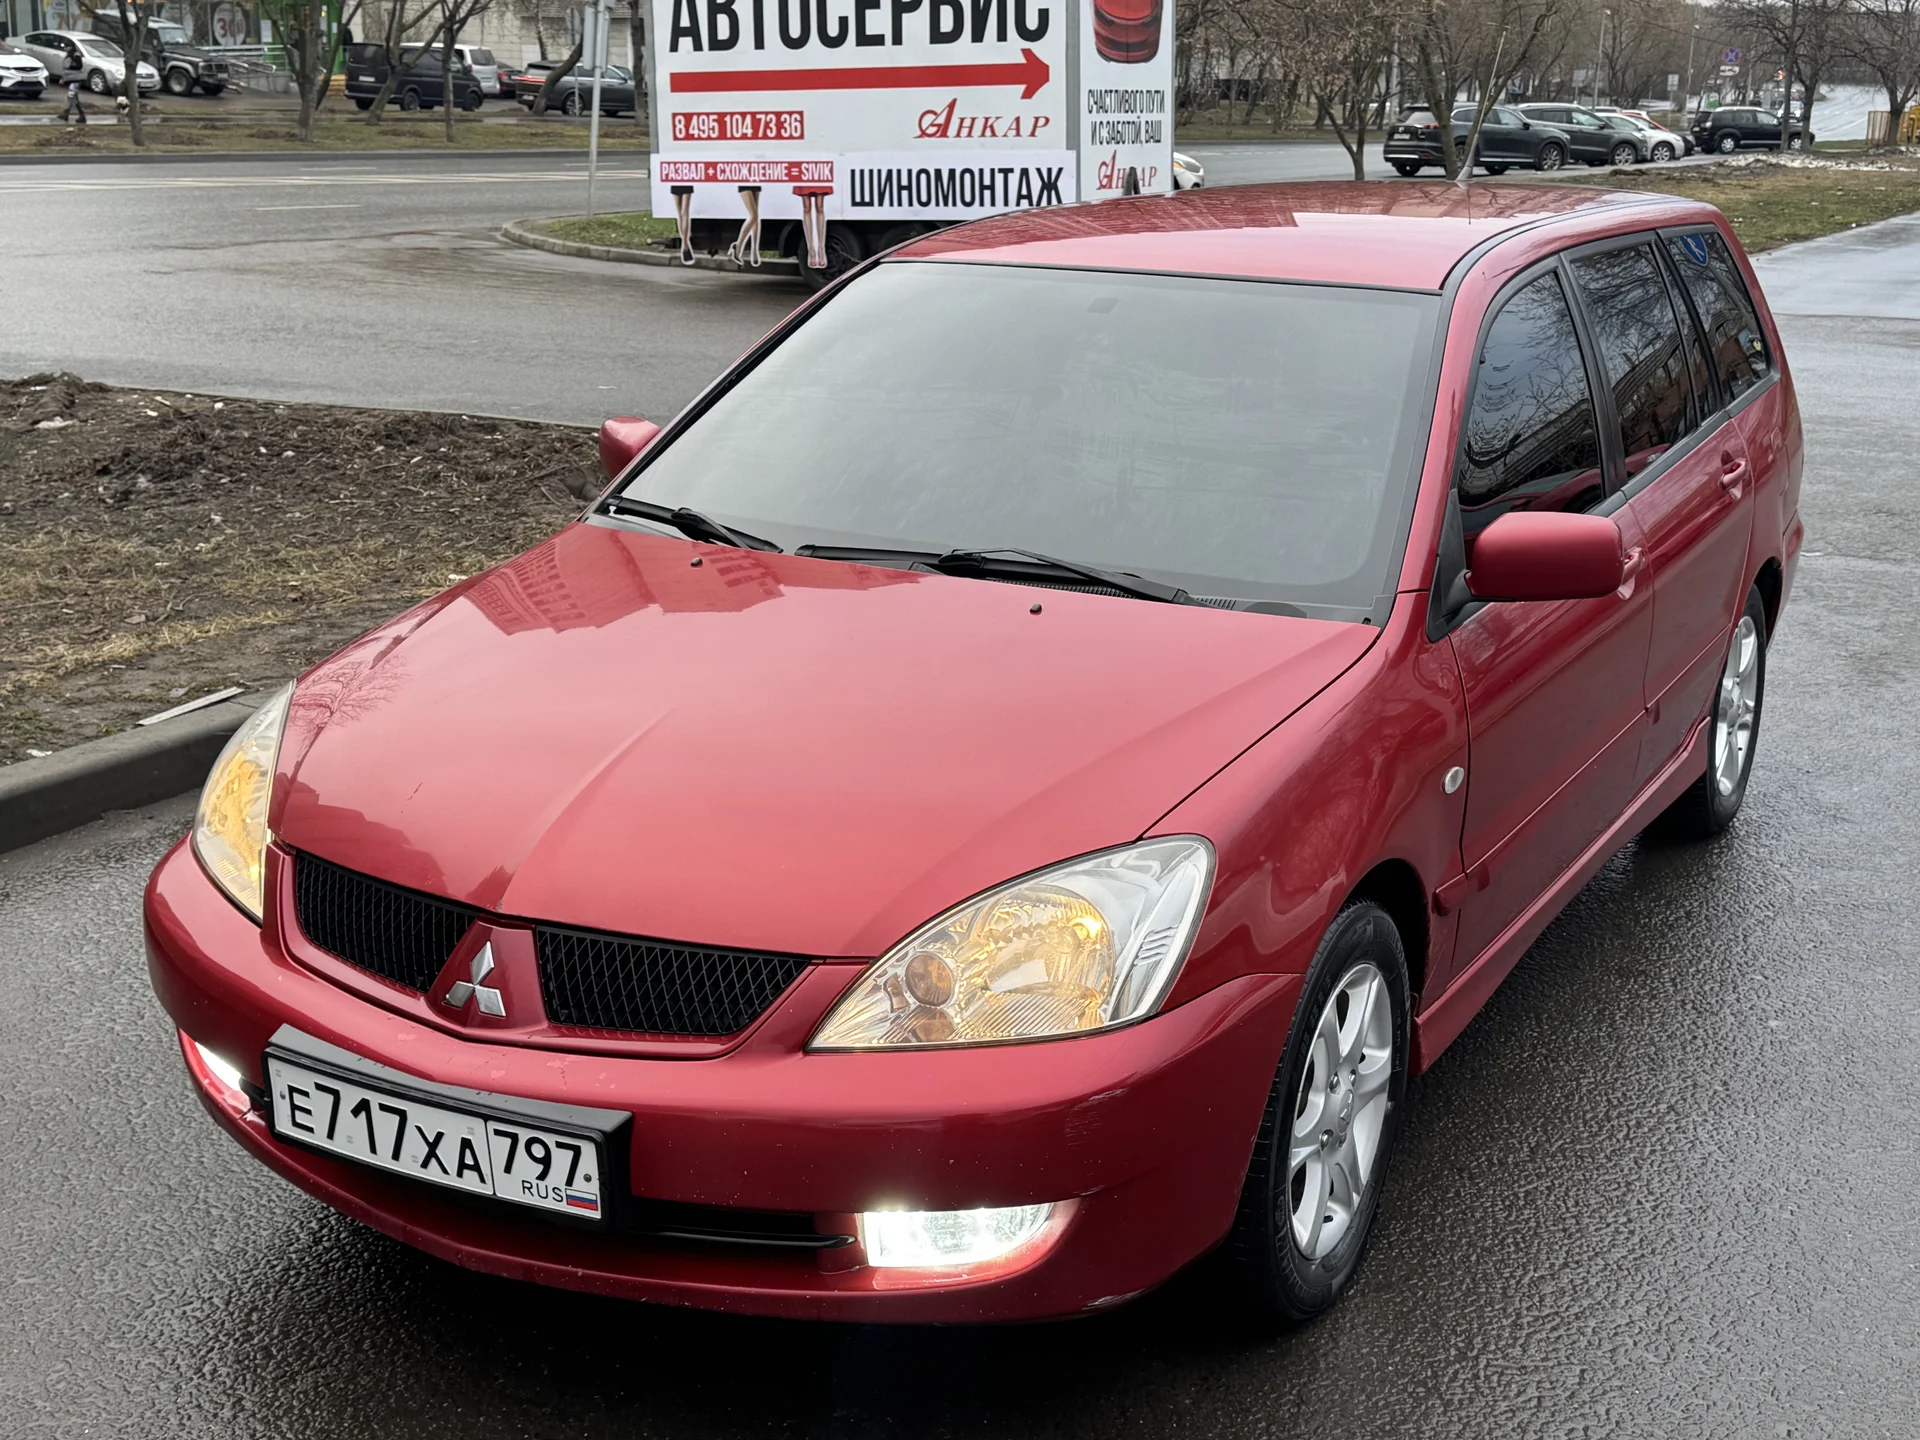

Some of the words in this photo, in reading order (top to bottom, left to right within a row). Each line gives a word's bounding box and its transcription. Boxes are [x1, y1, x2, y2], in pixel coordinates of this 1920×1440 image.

[669, 0, 1050, 52] АВТОСЕРВИС
[1087, 89, 1144, 114] СЧАСТЛИВОГО
[1145, 90, 1165, 114] ПУТИ
[675, 115, 686, 138] 8
[689, 115, 719, 138] 495
[724, 114, 753, 138] 104
[756, 114, 777, 138] 73
[780, 113, 801, 138] 36
[1091, 120, 1097, 146] И
[1098, 120, 1105, 145] С
[1145, 119, 1162, 143] ВАШ
[662, 163, 705, 181] РАЗВАЛ
[717, 162, 789, 182] СХОЖДЕНИЕ
[801, 162, 832, 181] SIVIK
[1096, 149, 1157, 190] АНАР
[850, 166, 1064, 208] ШИНОМОНТАЖ
[287, 1082, 487, 1185] Е717ХА
[493, 1128, 582, 1187] 797
[521, 1180, 564, 1203] RUS
